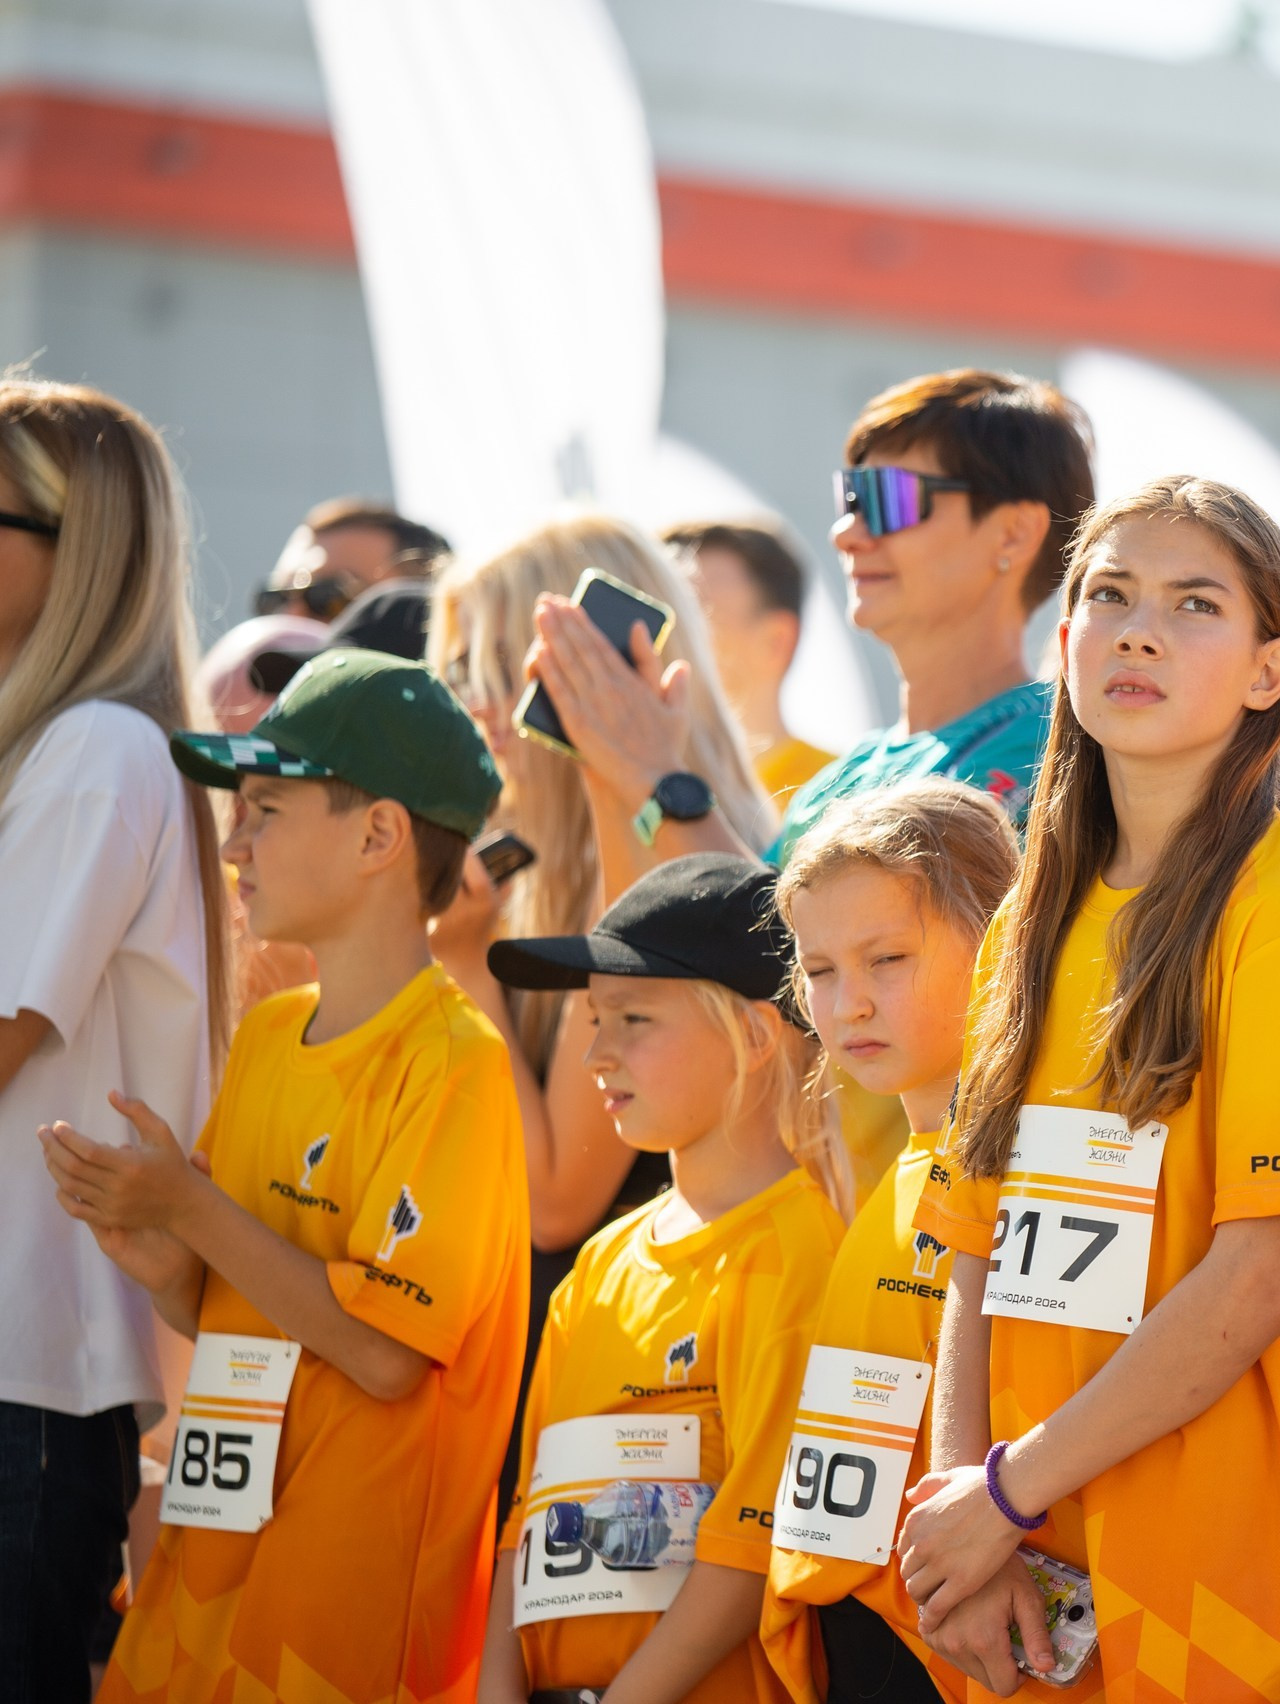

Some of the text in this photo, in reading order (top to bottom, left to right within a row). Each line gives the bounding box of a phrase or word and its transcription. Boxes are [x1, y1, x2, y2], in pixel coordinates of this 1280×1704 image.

[1089, 1126, 1135, 1143] ЭНЕРГИЯ
[1088, 1147, 1127, 1164] ЖИЗНИ
[365, 1265, 433, 1306] ЕФТЬ
[877, 1277, 947, 1301] РОСНЕФ
[1034, 1297, 1066, 1310] 2024
[853, 1366, 901, 1384] ЭНЕРГИЯ
[620, 1384, 718, 1398] РОСНЕФТ
[852, 1387, 891, 1404] ЖИЗНИ
